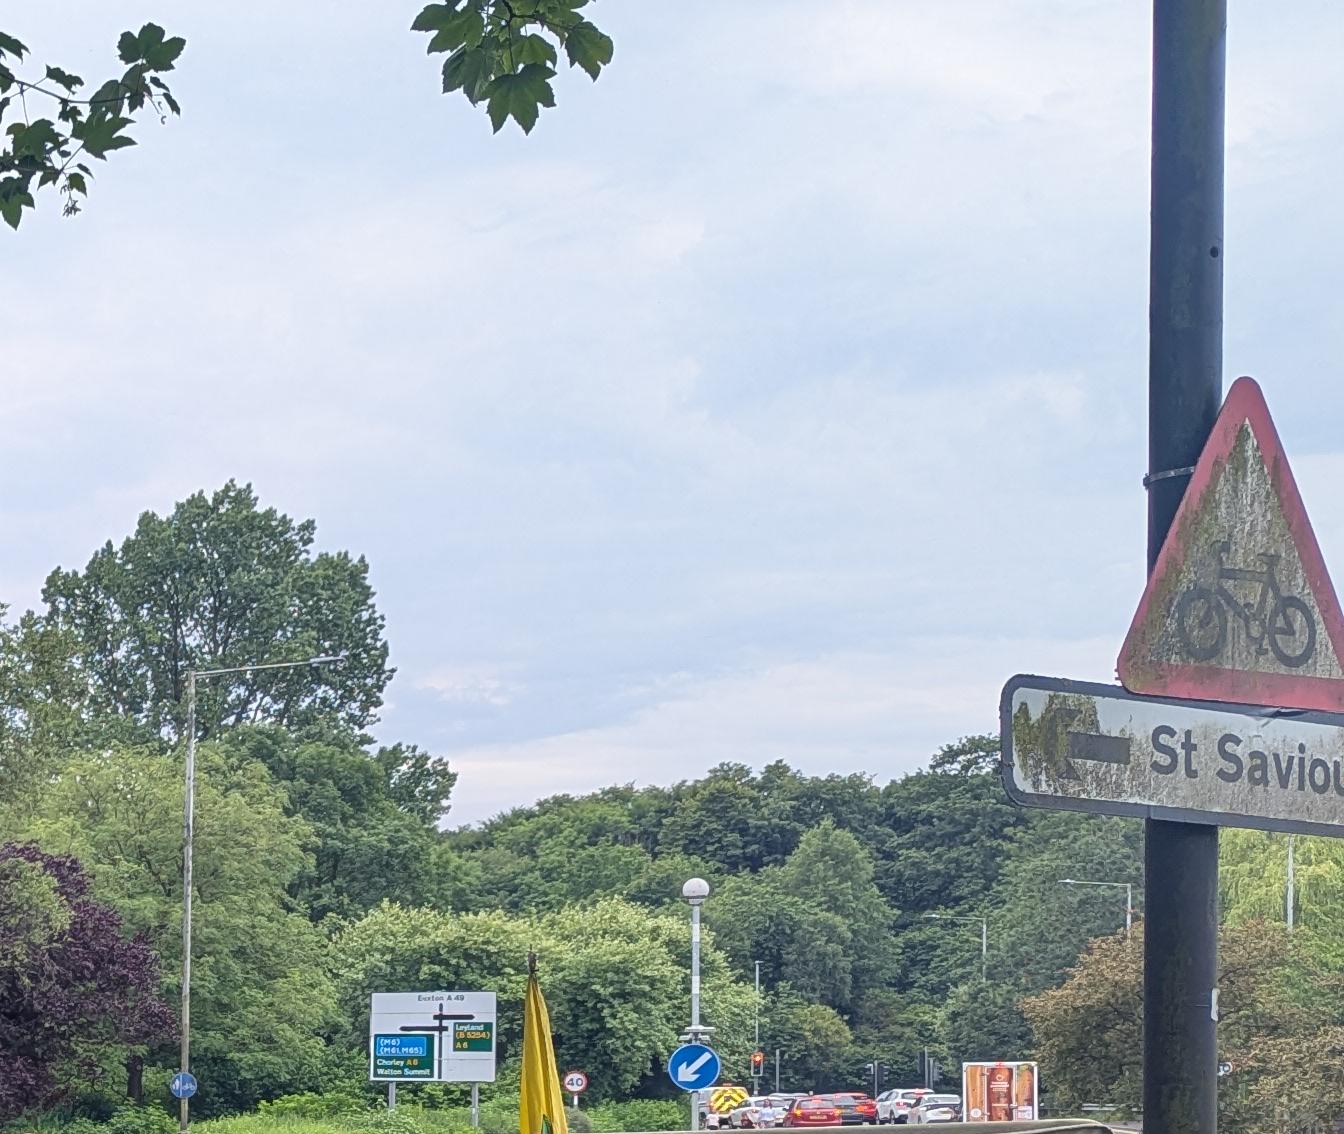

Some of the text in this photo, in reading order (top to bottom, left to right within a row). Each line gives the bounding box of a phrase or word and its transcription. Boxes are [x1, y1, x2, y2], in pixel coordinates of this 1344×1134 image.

[1150, 724, 1199, 779] St
[404, 1068, 430, 1076] Summit
[567, 1078, 583, 1086] 40
